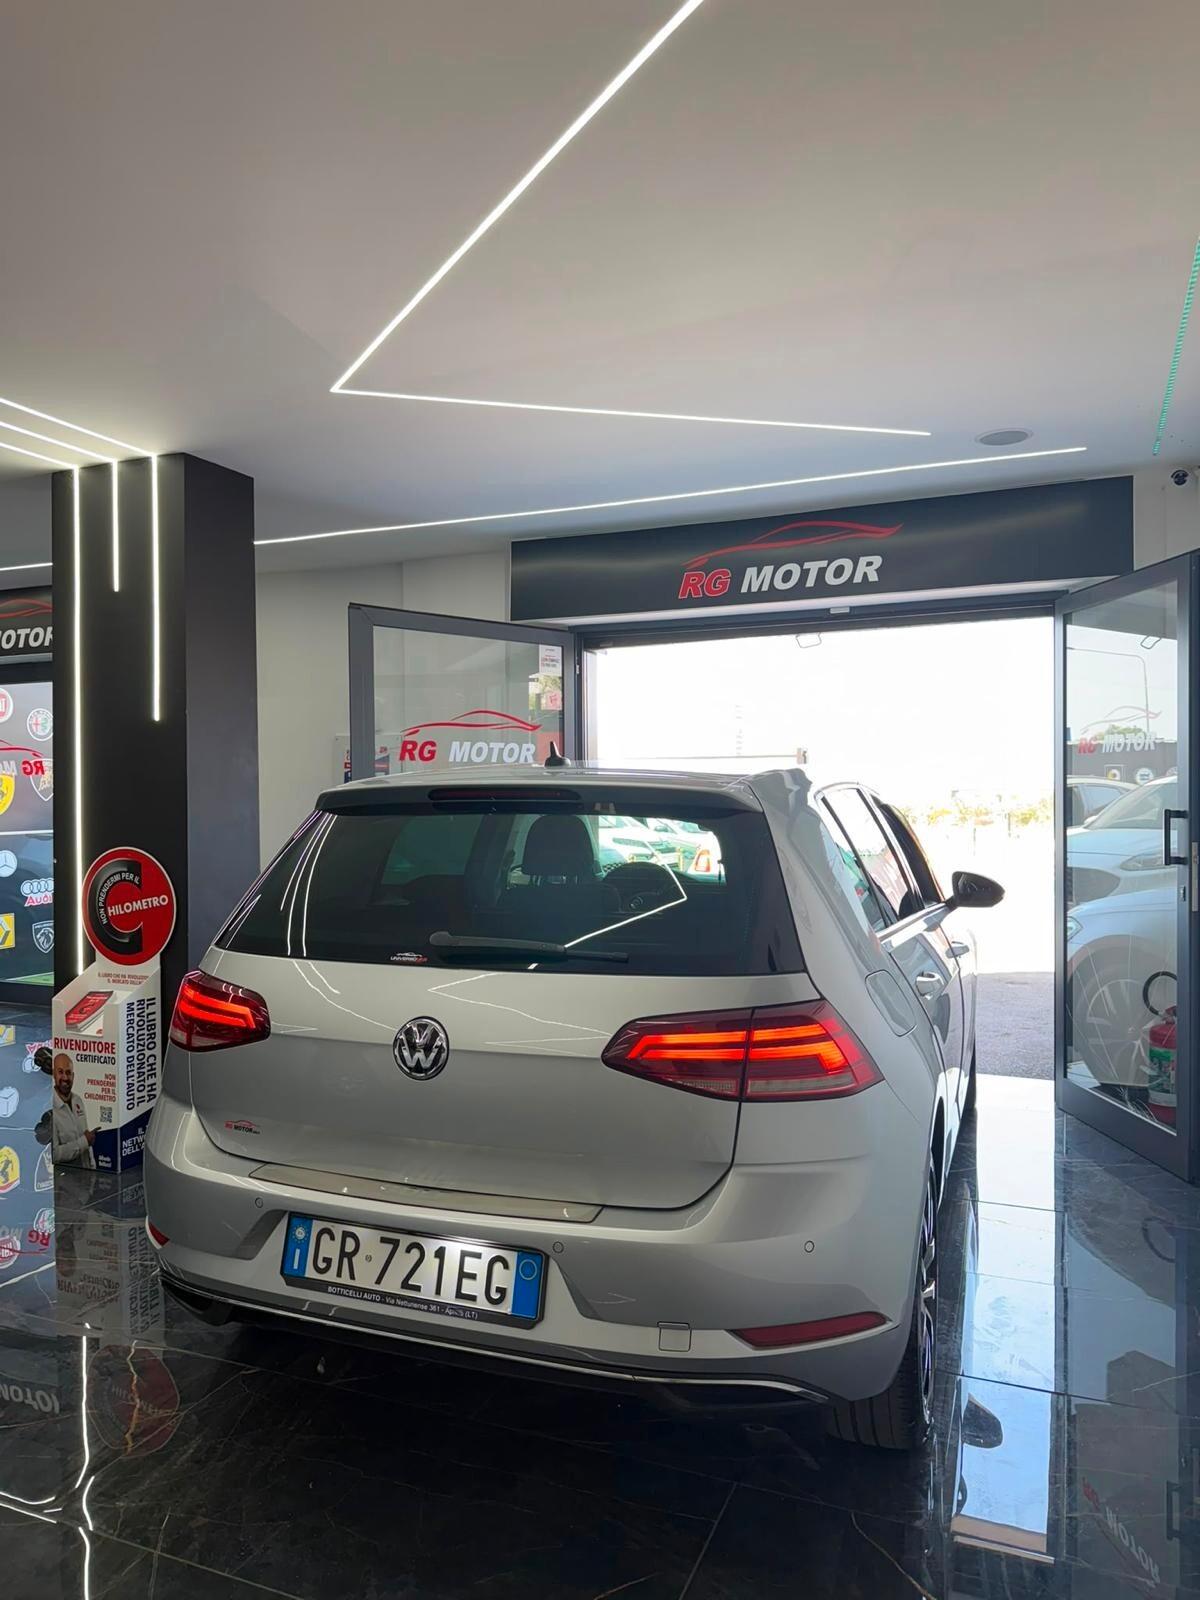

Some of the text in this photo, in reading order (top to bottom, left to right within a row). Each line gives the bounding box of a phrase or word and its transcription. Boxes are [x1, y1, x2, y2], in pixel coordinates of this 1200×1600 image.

[678, 555, 883, 599] RG MOTOR
[399, 740, 536, 763] RG MOTOR
[121, 872, 134, 880] PER
[54, 1037, 116, 1055] RIVENDITORE
[126, 1002, 135, 1110] MERCATO DELL'AUTO
[136, 998, 146, 1107] RIVOLUZIONATO IL
[146, 997, 157, 1103] IL LIBRO CHE HA
[75, 1053, 116, 1066] CERTIFICATO
[122, 1134, 145, 1149] NETW
[312, 1227, 361, 1281] GR
[374, 1236, 510, 1306] 721EG
[327, 1286, 363, 1299] BOTTICELLI
[363, 1293, 381, 1302] AUTO
